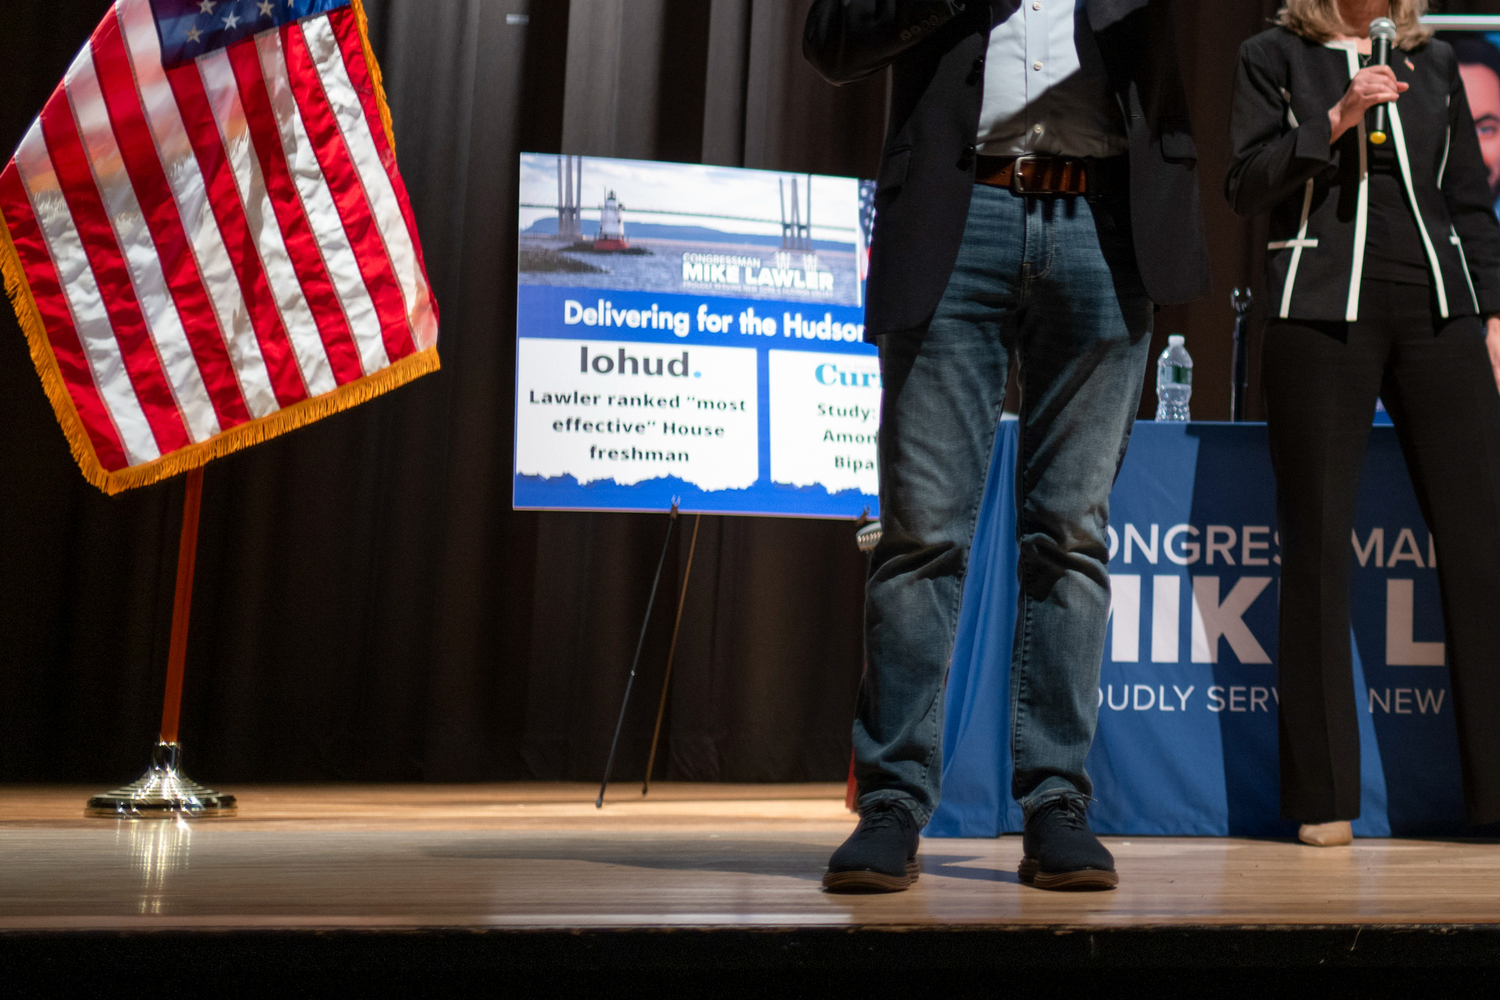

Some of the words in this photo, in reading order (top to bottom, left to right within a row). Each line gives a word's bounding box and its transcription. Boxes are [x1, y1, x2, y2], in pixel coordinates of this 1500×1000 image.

[682, 262, 740, 284] MIKE
[745, 267, 835, 292] LAWLER
[564, 299, 690, 337] Delivering
[697, 303, 734, 334] for
[739, 306, 778, 337] the
[814, 362, 883, 389] Cur
[529, 389, 601, 406] Lawler
[607, 393, 681, 410] ranked
[687, 395, 747, 412] "most
[552, 417, 656, 435] effective"
[663, 421, 726, 438] House
[589, 445, 690, 463] freshman
[1098, 683, 1195, 712] UDLY
[1368, 687, 1446, 715] NEW
